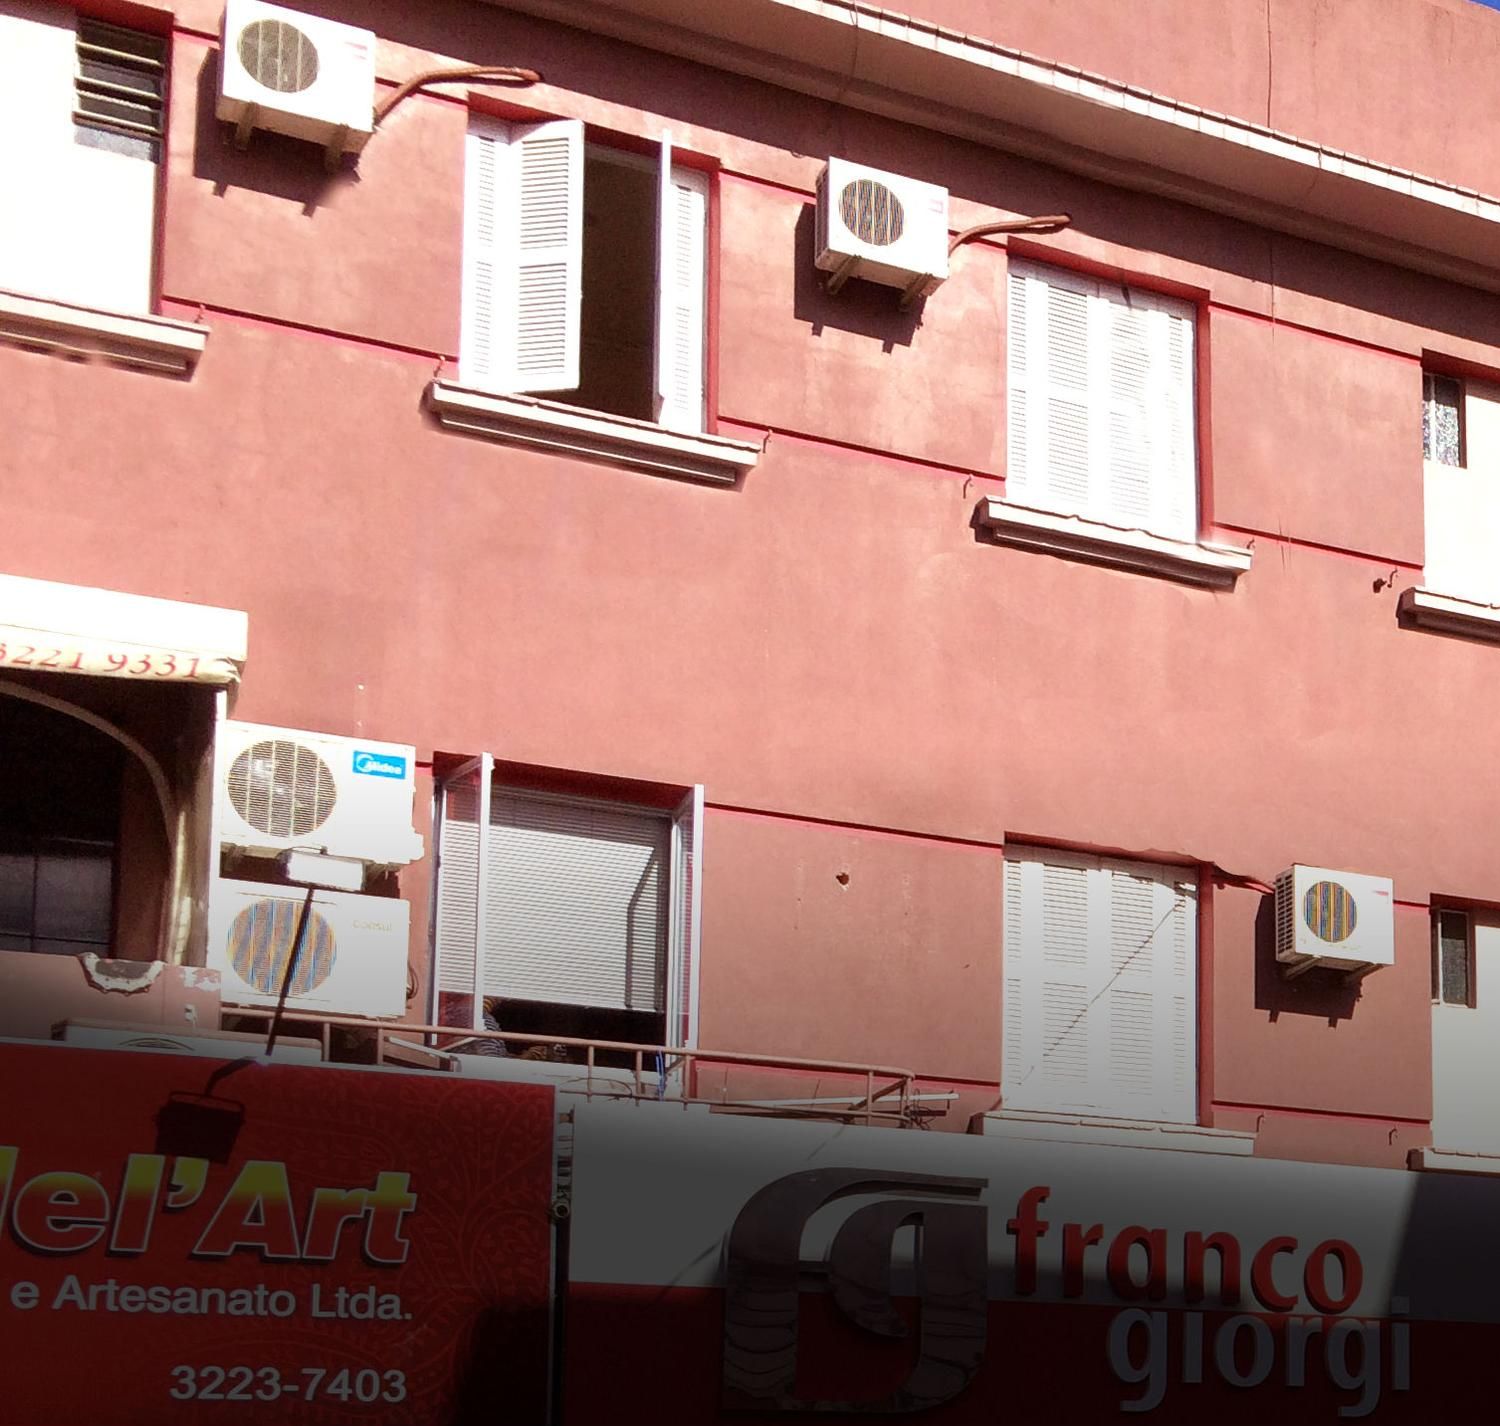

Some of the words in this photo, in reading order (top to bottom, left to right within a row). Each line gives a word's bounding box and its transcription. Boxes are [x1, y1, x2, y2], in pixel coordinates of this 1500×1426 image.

[103, 653, 200, 679] 9331
[1007, 1186, 1363, 1314] franco
[12, 1281, 39, 1310] e
[52, 1275, 296, 1317] Artesanato
[311, 1283, 412, 1320] Ltda.
[1107, 1296, 1411, 1418] giorgi
[169, 1366, 407, 1402] 3223-7403
